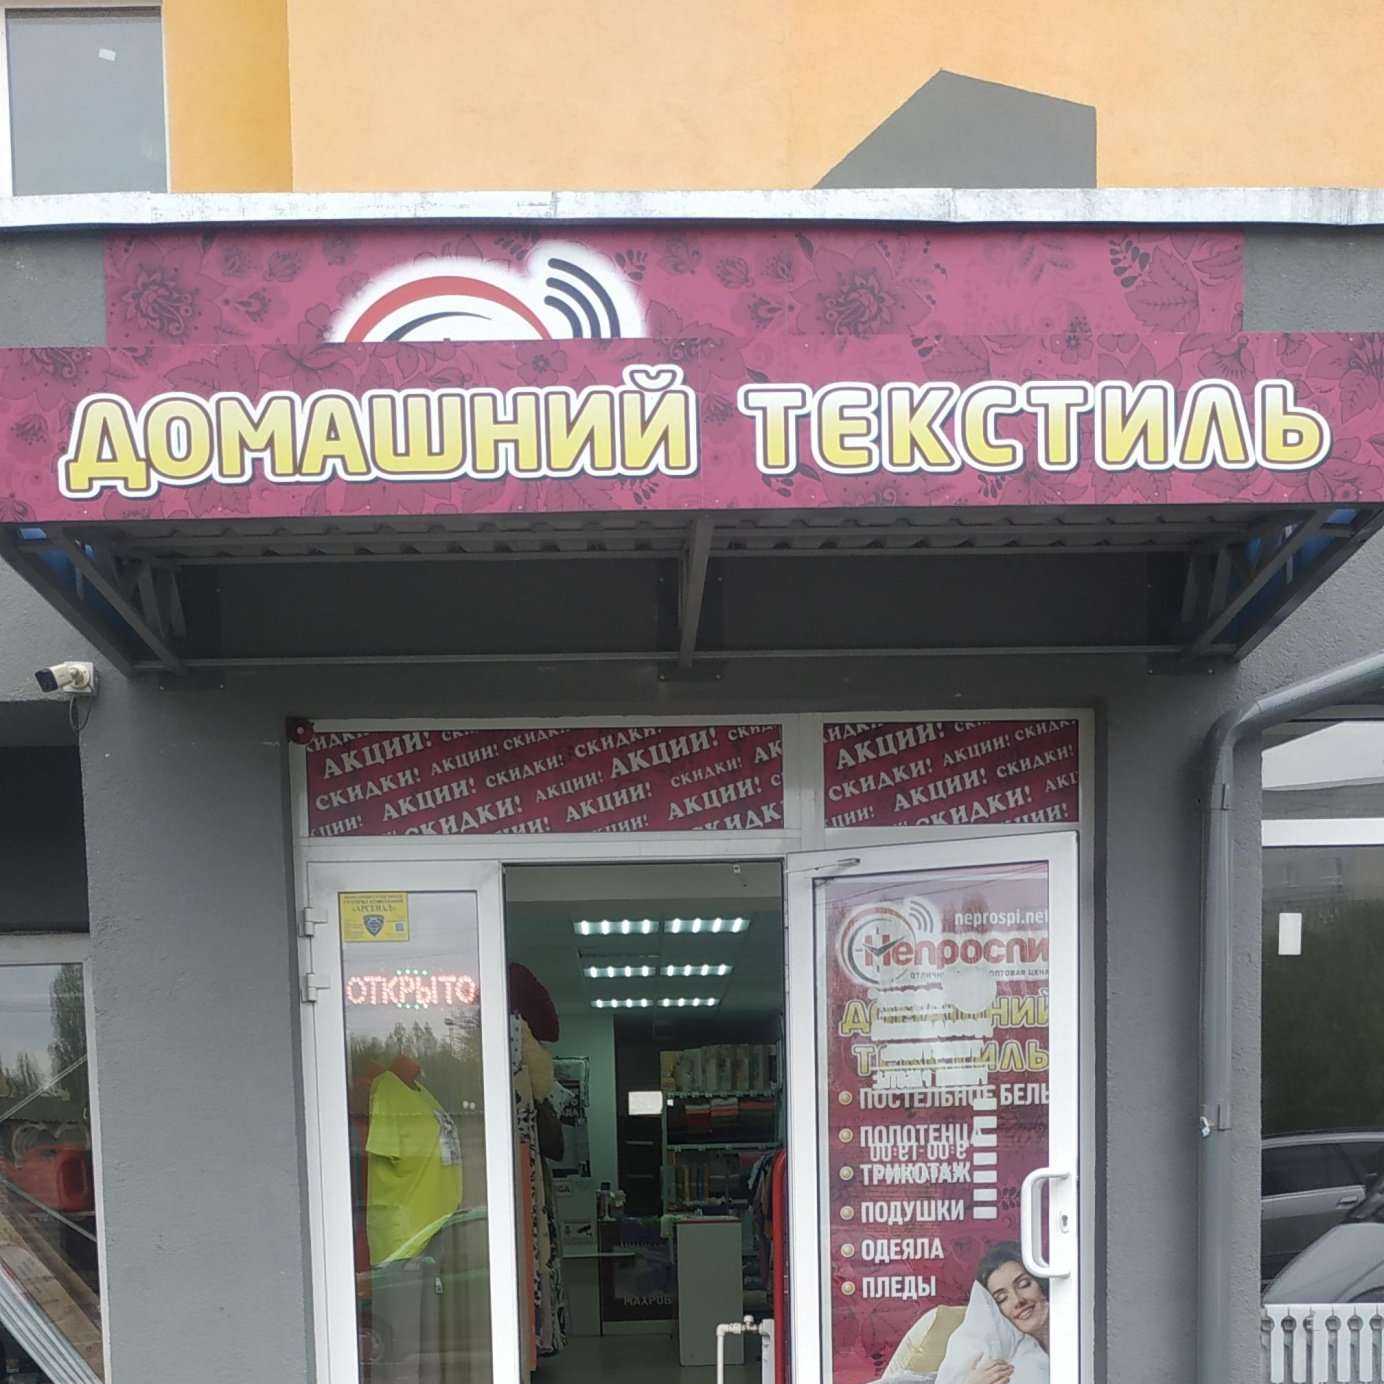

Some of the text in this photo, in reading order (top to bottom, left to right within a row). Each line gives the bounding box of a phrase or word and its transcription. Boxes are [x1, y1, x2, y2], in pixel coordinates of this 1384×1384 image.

[60, 365, 1331, 497] ДОМАШНИЙ ТЕКСТИЛЬ
[323, 732, 432, 779] АКЦИИ!
[536, 771, 603, 803] АКЦИИ!
[611, 727, 718, 779] АКЦИИ!
[829, 758, 933, 801] СКИДКИ!
[944, 734, 1010, 766] АКЦИИ!
[837, 722, 944, 770] АКЦИИ!
[311, 728, 662, 836] ЦИИ! АКЦИИ! СКИДКИ! СКИДКИ
[315, 768, 421, 811] СКИДКИ!
[431, 744, 499, 775] АКЦИИ!
[566, 782, 652, 823] АКЦИИ!
[671, 757, 743, 788] СКИДКИ!
[668, 777, 762, 820] АКЦИИ!
[824, 744, 1075, 828] ЦИИ! АКЦИИ! СКИДКИ!
[347, 975, 476, 1005] ОТКРЫТО
[859, 1083, 1048, 1108] ПОСТЕЛЬНОЕ БЕЛЬ
[859, 1161, 972, 1186] ТРИКОТАЖ
[861, 1200, 965, 1224] ПОДУШКИ
[861, 1238, 944, 1264] ОДЕЯЛА
[862, 1276, 937, 1300] ПЛЕДЫ
